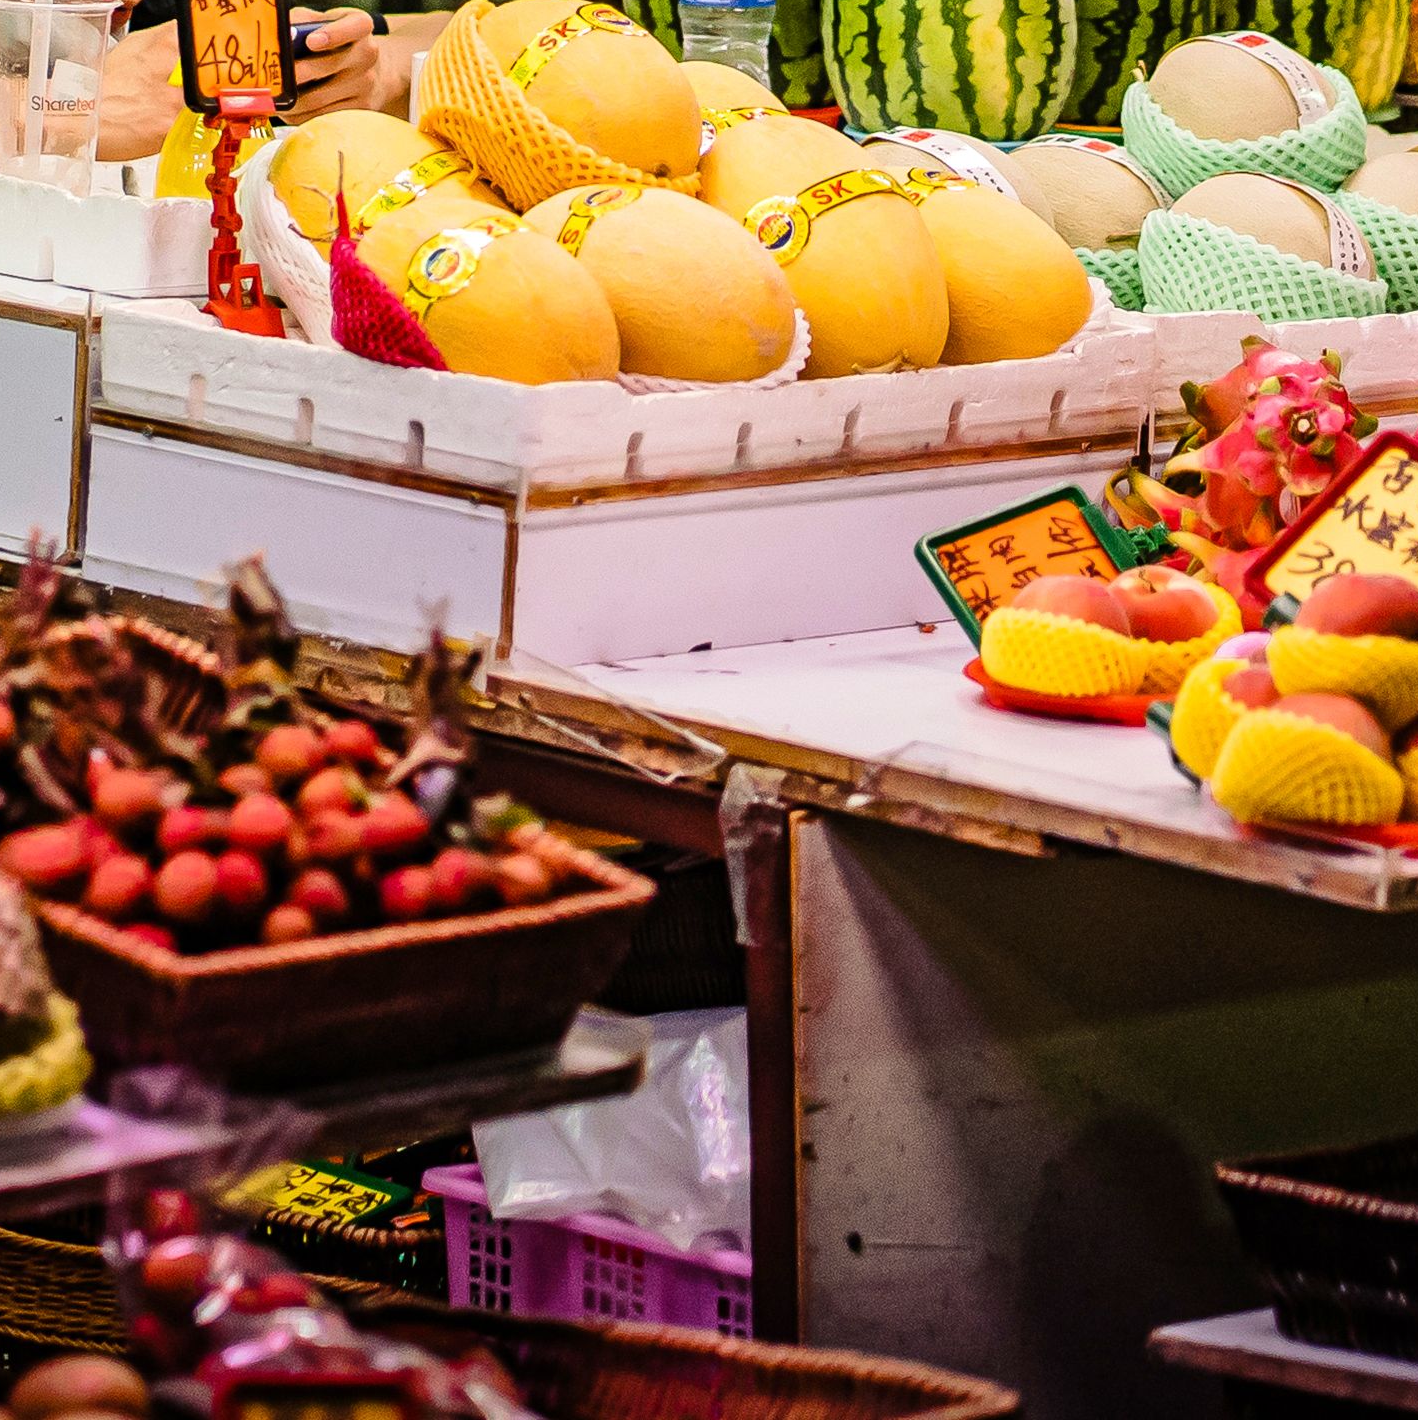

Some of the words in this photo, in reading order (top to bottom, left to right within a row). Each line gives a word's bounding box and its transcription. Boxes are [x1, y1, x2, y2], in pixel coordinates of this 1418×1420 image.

[538, 20, 577, 52] SK
[30, 95, 97, 113] Sharetea
[811, 179, 854, 206] SK
